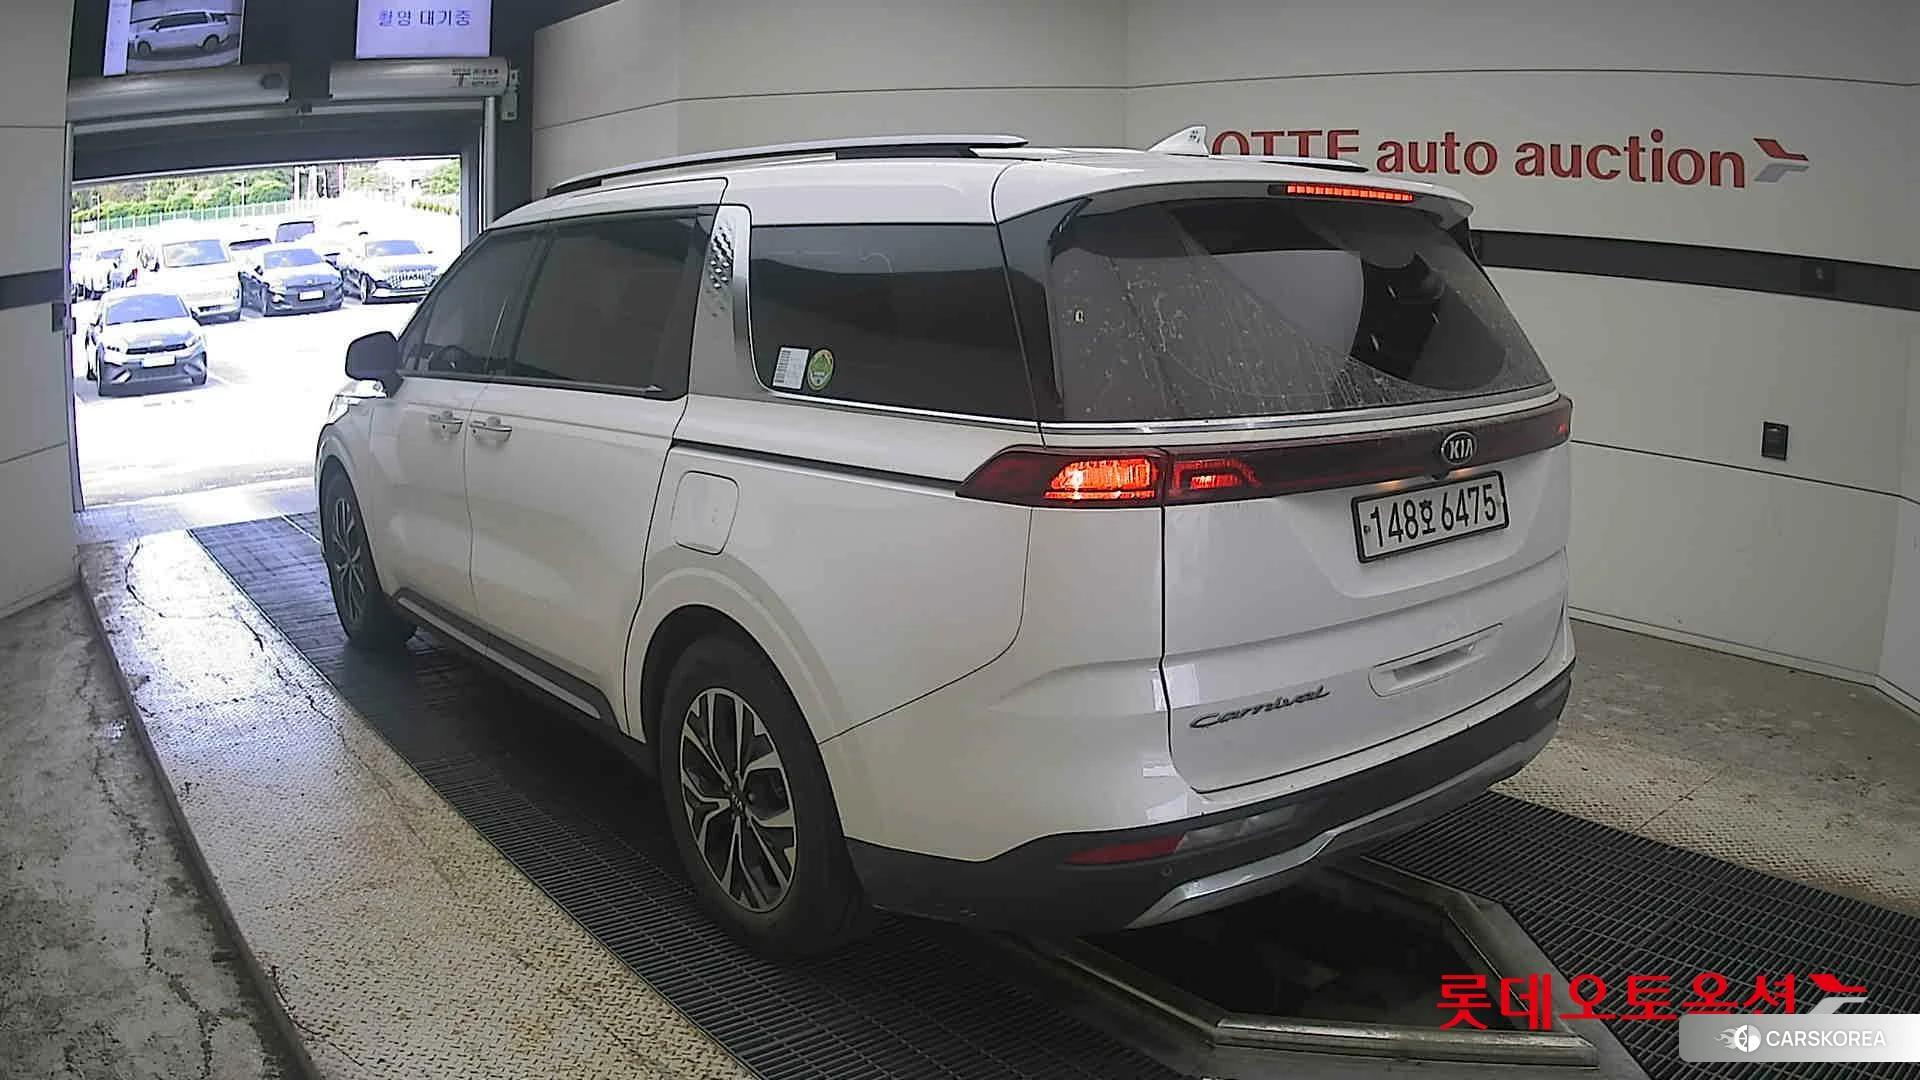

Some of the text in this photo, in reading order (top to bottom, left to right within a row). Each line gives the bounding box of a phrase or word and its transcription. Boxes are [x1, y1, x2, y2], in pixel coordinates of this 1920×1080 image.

[420, 9, 472, 27] 대기중
[1377, 132, 1497, 174] auto
[1515, 129, 1745, 187] auction
[1449, 439, 1473, 460] KIA
[1370, 484, 1496, 547] 148호 6475
[1189, 685, 1330, 728] Carnival
